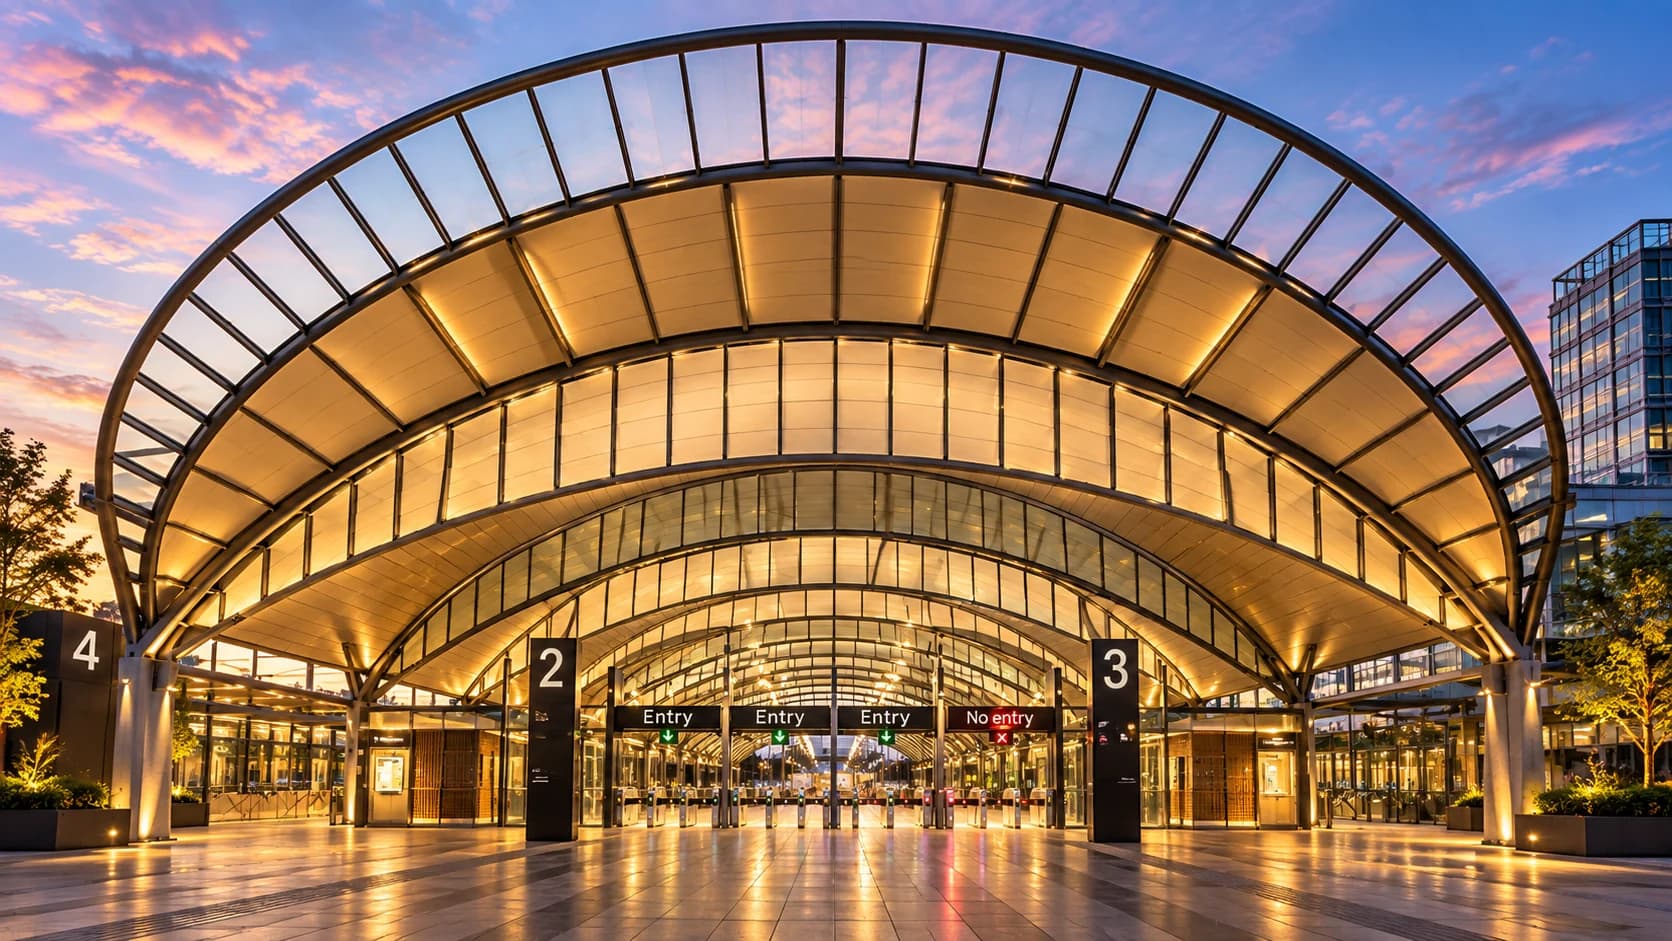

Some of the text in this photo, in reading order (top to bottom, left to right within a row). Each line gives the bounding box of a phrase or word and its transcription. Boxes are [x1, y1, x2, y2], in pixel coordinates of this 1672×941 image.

[73, 631, 99, 670] 4
[540, 648, 563, 687] 2
[1103, 648, 1128, 689] 3
[643, 709, 693, 727] Entry
[756, 709, 805, 727] Entry
[861, 709, 911, 727] Entry
[967, 710, 1034, 728] No entry
